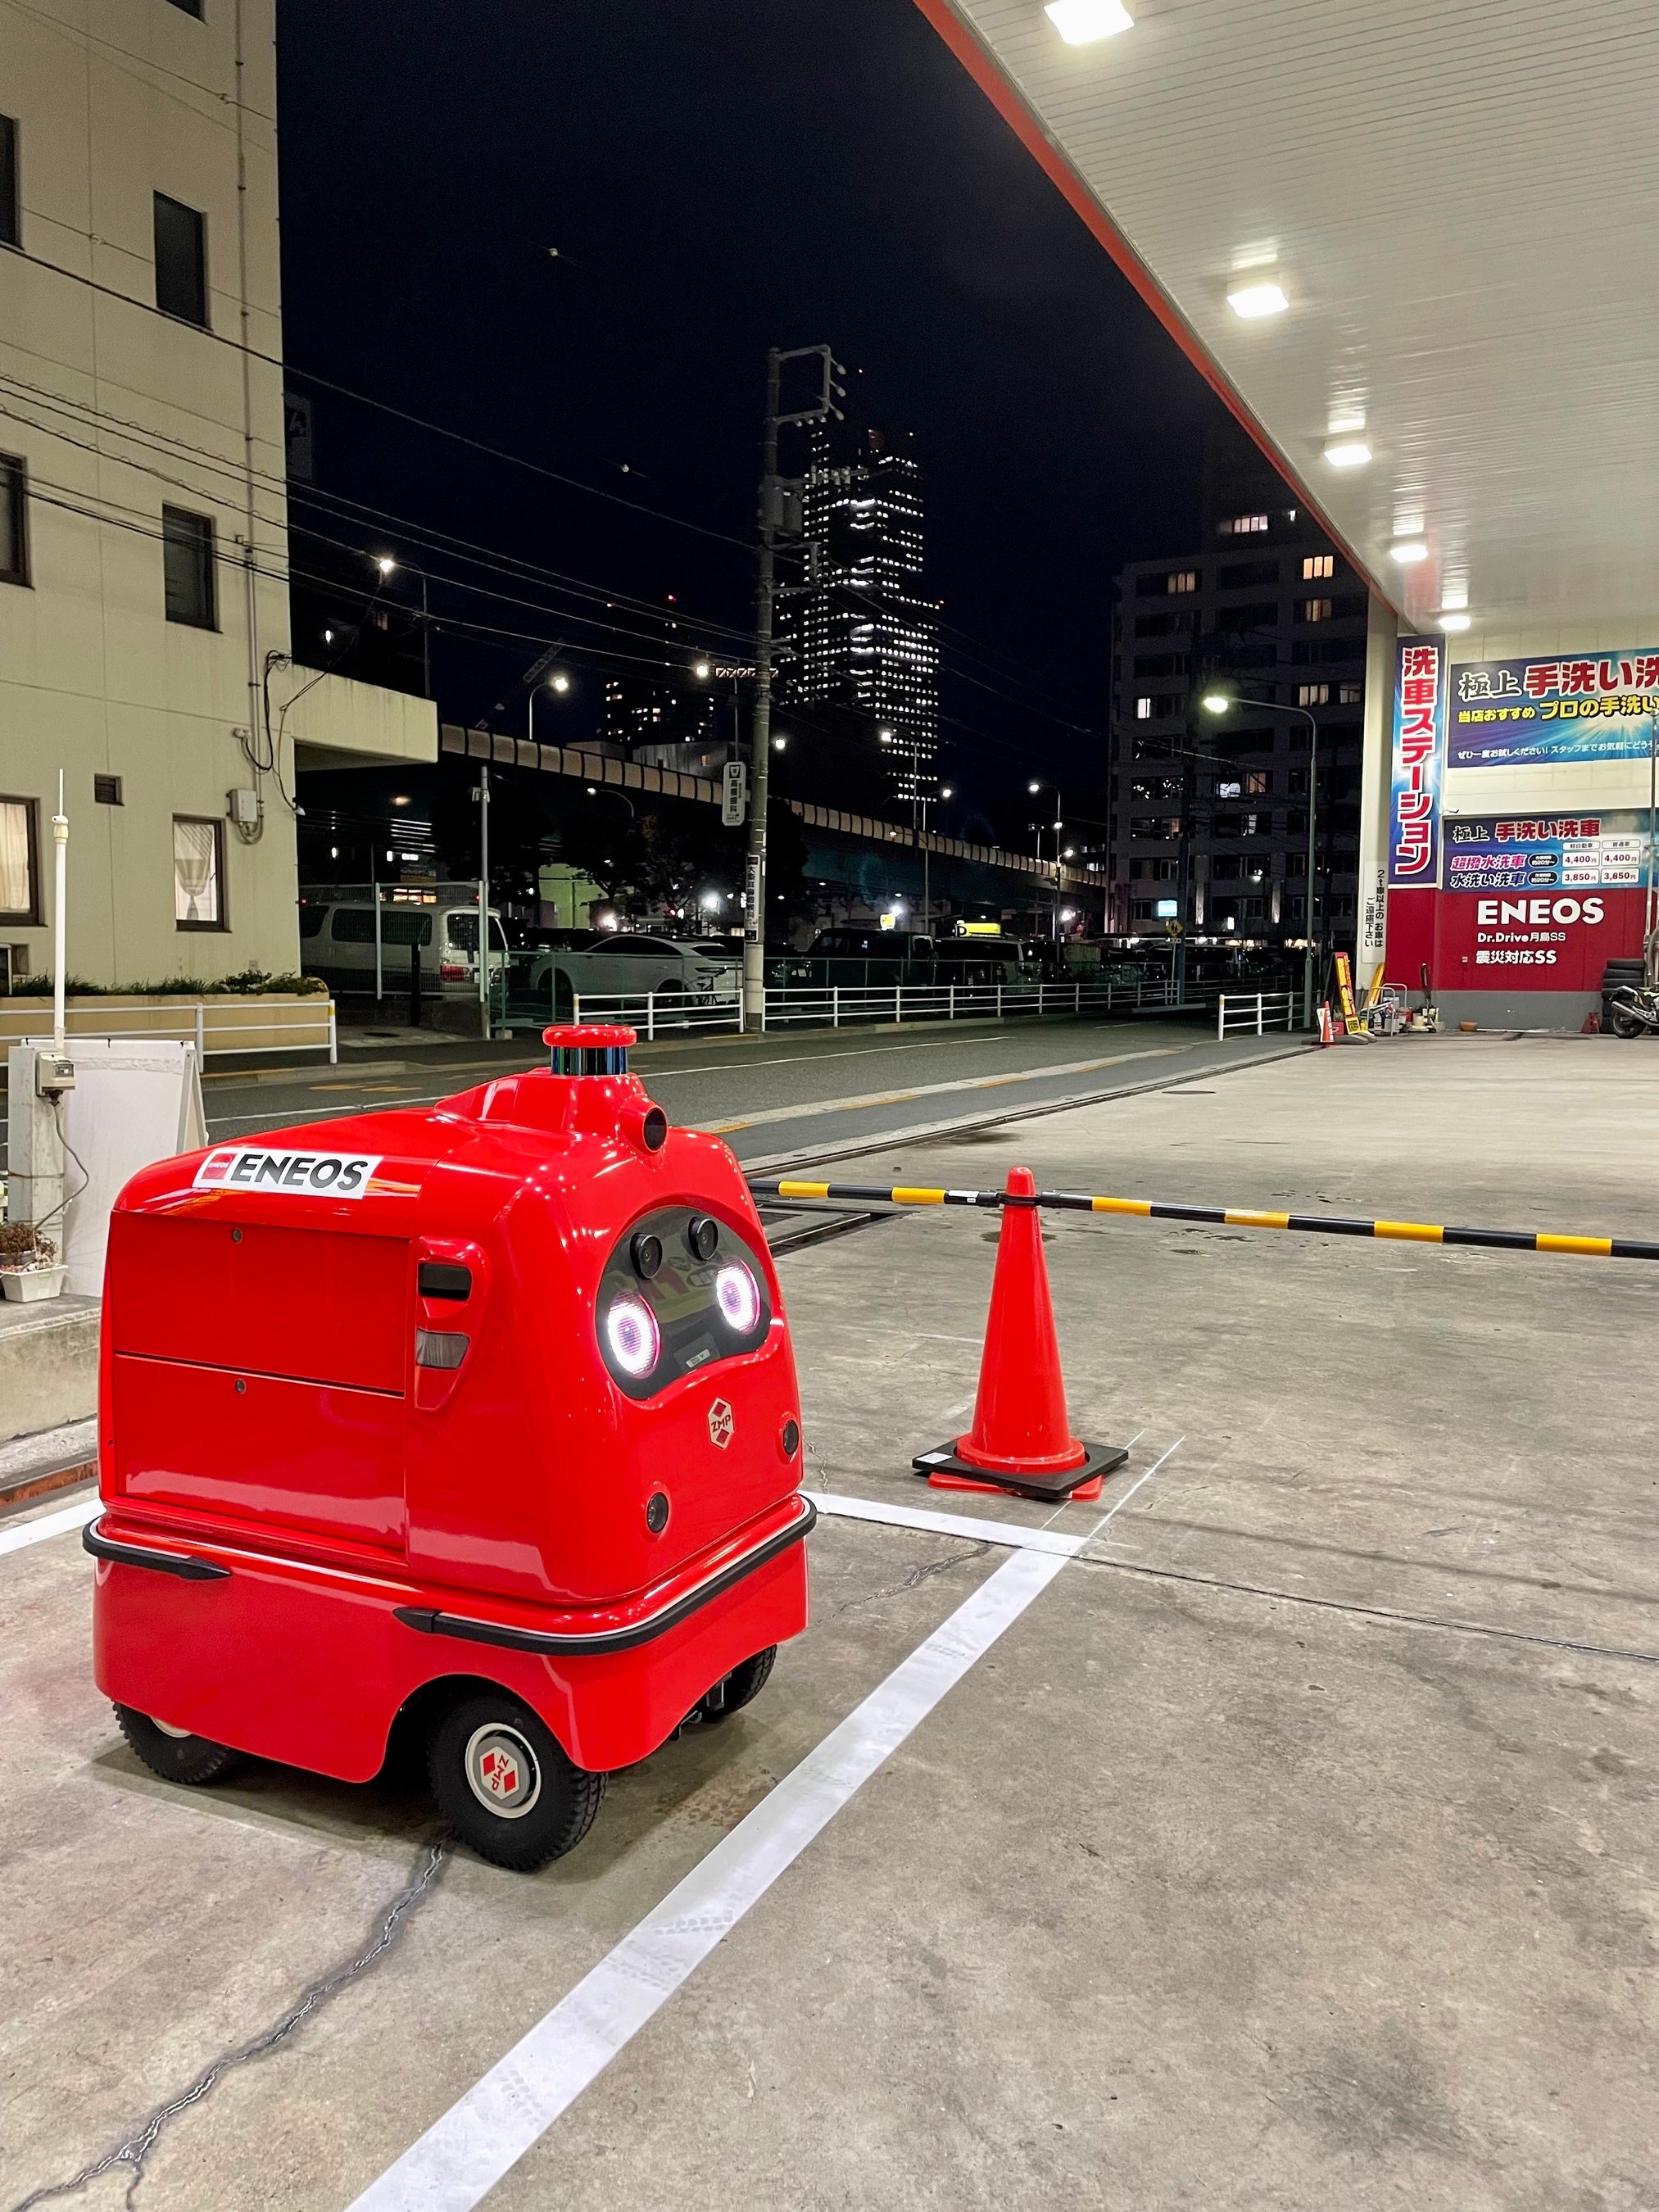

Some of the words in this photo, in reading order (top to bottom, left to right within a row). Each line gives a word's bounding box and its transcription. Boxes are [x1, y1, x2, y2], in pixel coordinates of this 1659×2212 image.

[1458, 670, 1522, 701] 極上
[1457, 707, 1535, 723] 当店おすすめ
[1396, 647, 1437, 874] 洗車ステーション
[1453, 826, 1490, 843] 極上
[1495, 818, 1601, 842] 手洗い洗車
[1450, 854, 1527, 871] 超撥水洗車
[1450, 871, 1526, 888] 水洗い洗車
[1365, 897, 1376, 948] ご遠慮下さい
[1477, 897, 1605, 925] ENEOS
[1475, 950, 1557, 964] 震災対応SS
[230, 1154, 369, 1190] ENEOS
[711, 1414, 731, 1432] ZMP
[492, 1754, 509, 1791] ZMP
